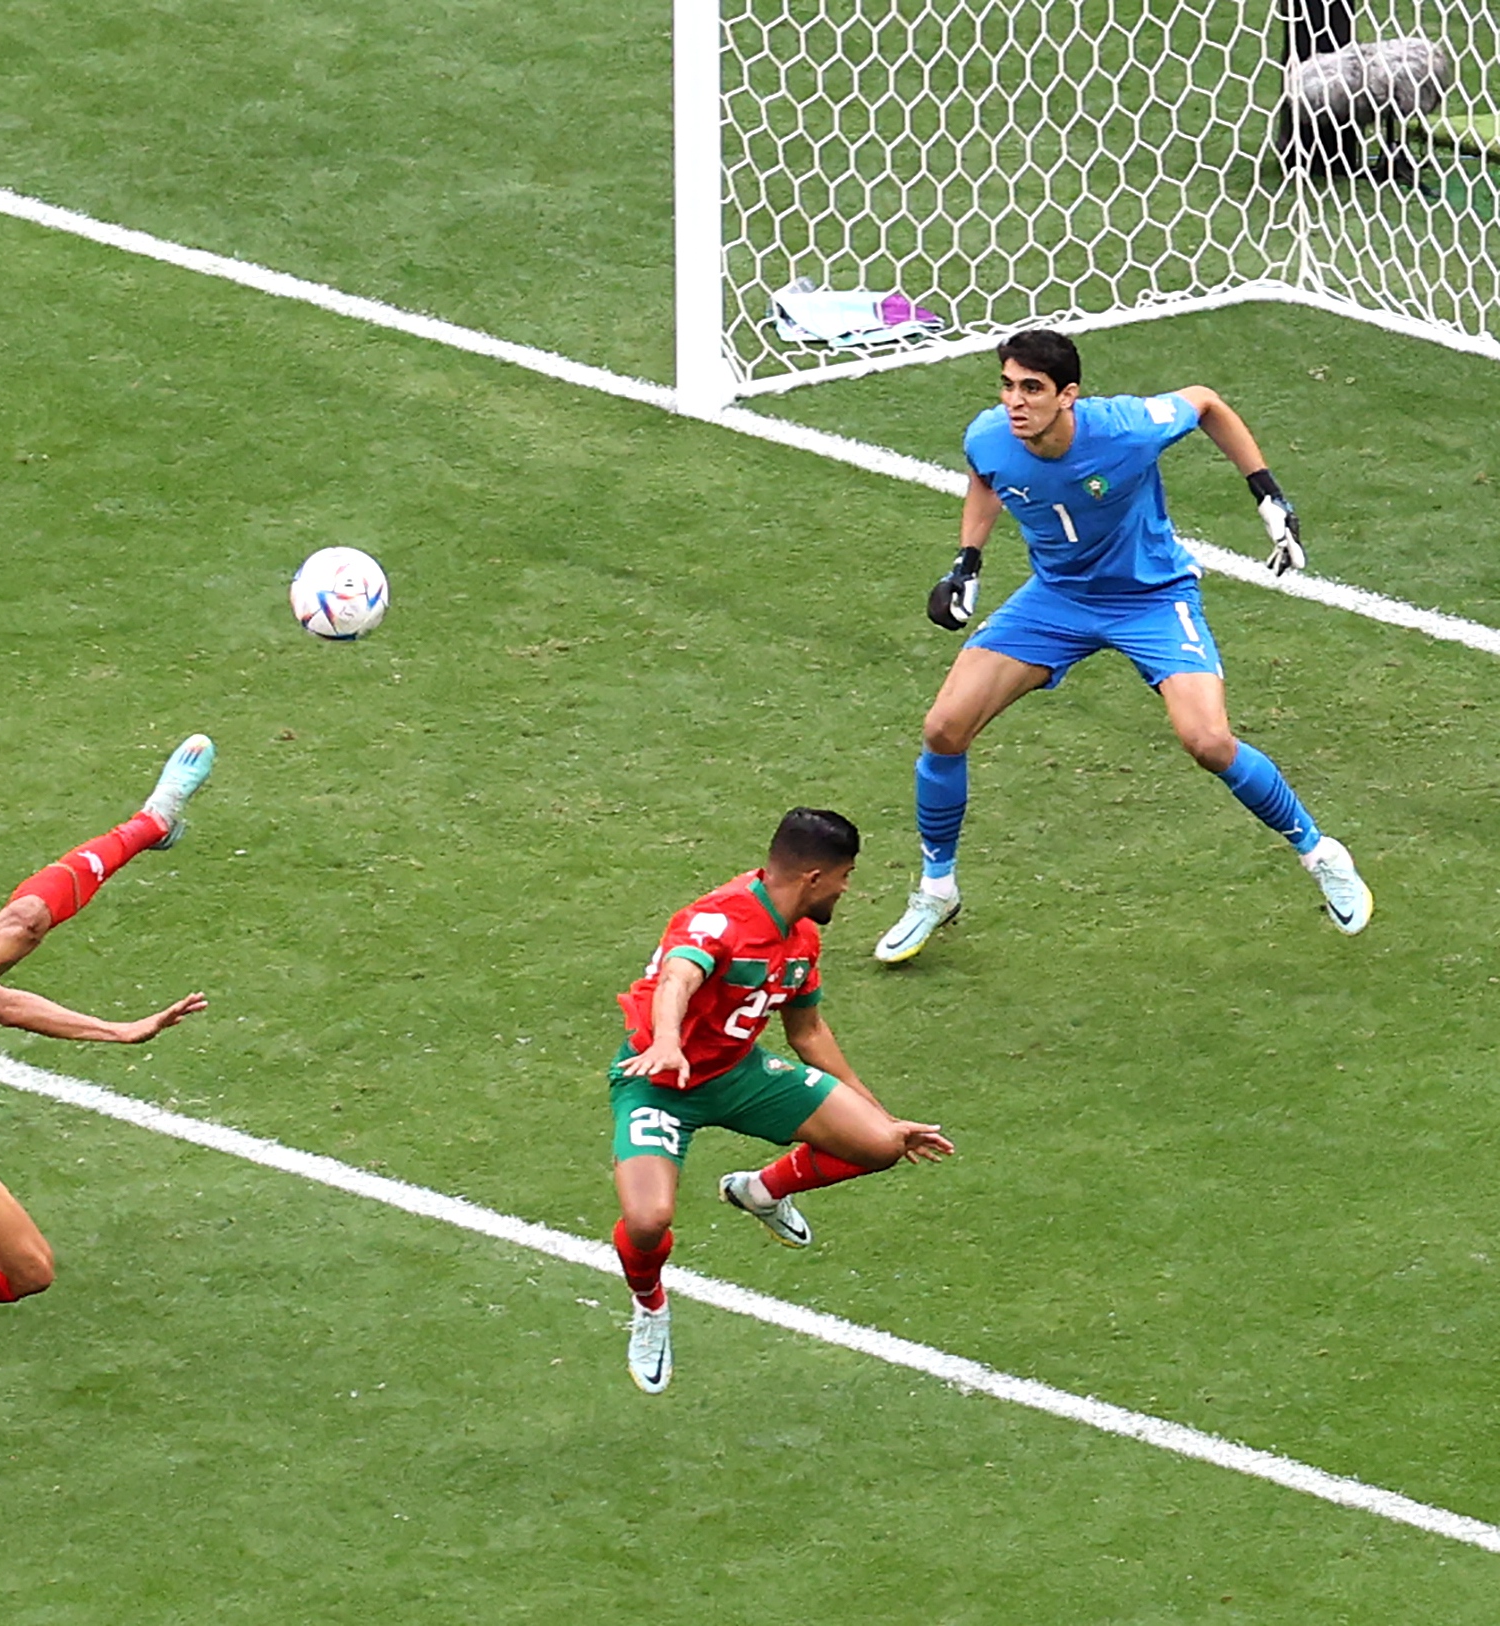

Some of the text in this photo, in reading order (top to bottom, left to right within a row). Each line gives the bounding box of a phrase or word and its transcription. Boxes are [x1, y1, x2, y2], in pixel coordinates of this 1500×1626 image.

[1052, 503, 1078, 543] 1
[1174, 601, 1199, 641] 1
[629, 1106, 681, 1155] 25
